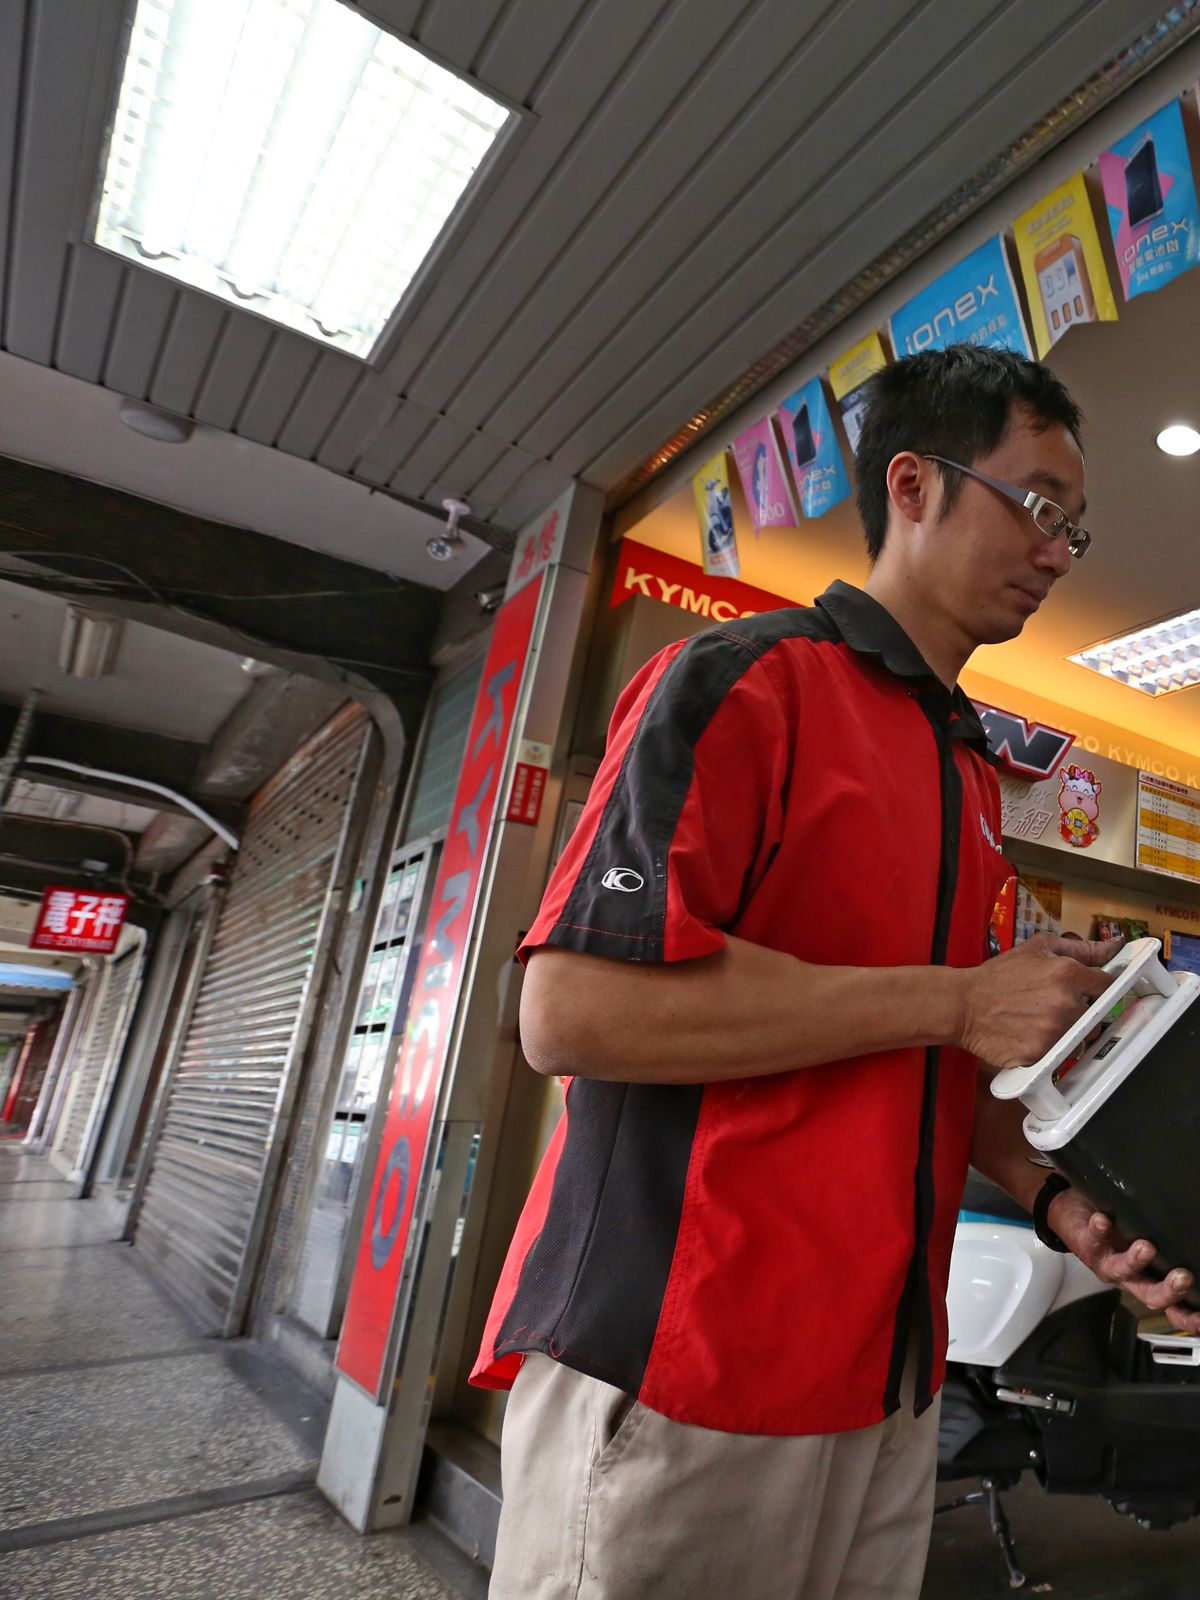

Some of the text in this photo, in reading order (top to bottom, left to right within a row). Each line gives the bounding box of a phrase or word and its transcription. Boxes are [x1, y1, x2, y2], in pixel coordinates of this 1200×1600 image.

[904, 273, 999, 354] ionex
[624, 567, 757, 623] KYMC
[1108, 742, 1181, 780] KYMCO
[42, 891, 126, 938] 電子秤
[372, 658, 518, 1270] KYMCO
